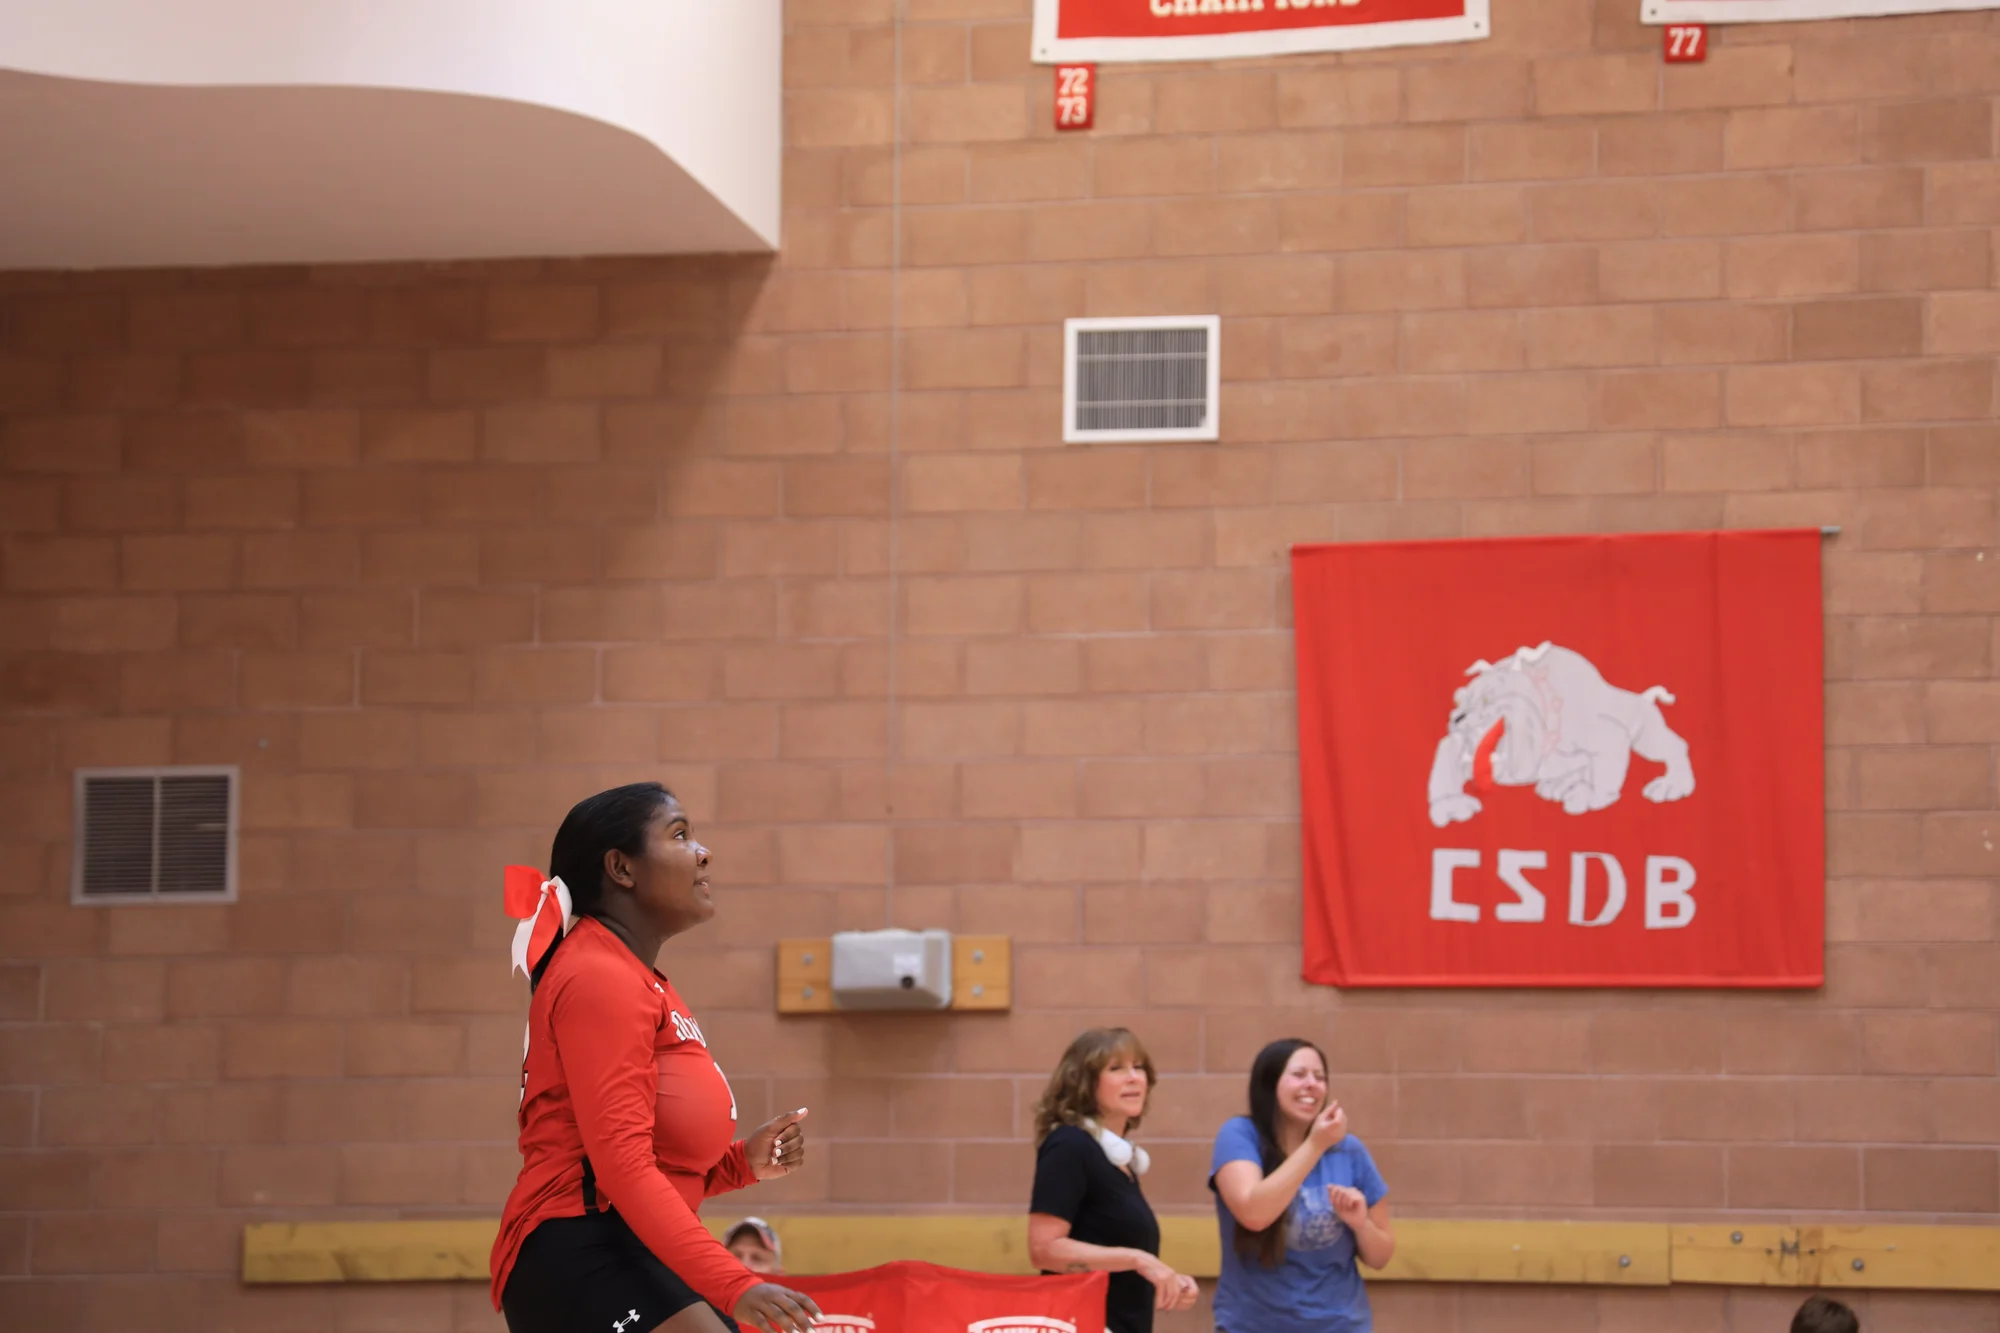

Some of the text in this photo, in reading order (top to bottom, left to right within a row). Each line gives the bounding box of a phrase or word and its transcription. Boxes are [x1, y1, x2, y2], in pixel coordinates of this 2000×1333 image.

[1669, 27, 1702, 56] 77
[1059, 67, 1088, 96] 72
[1057, 96, 1087, 124] 73
[1430, 848, 1697, 929] CSDB
